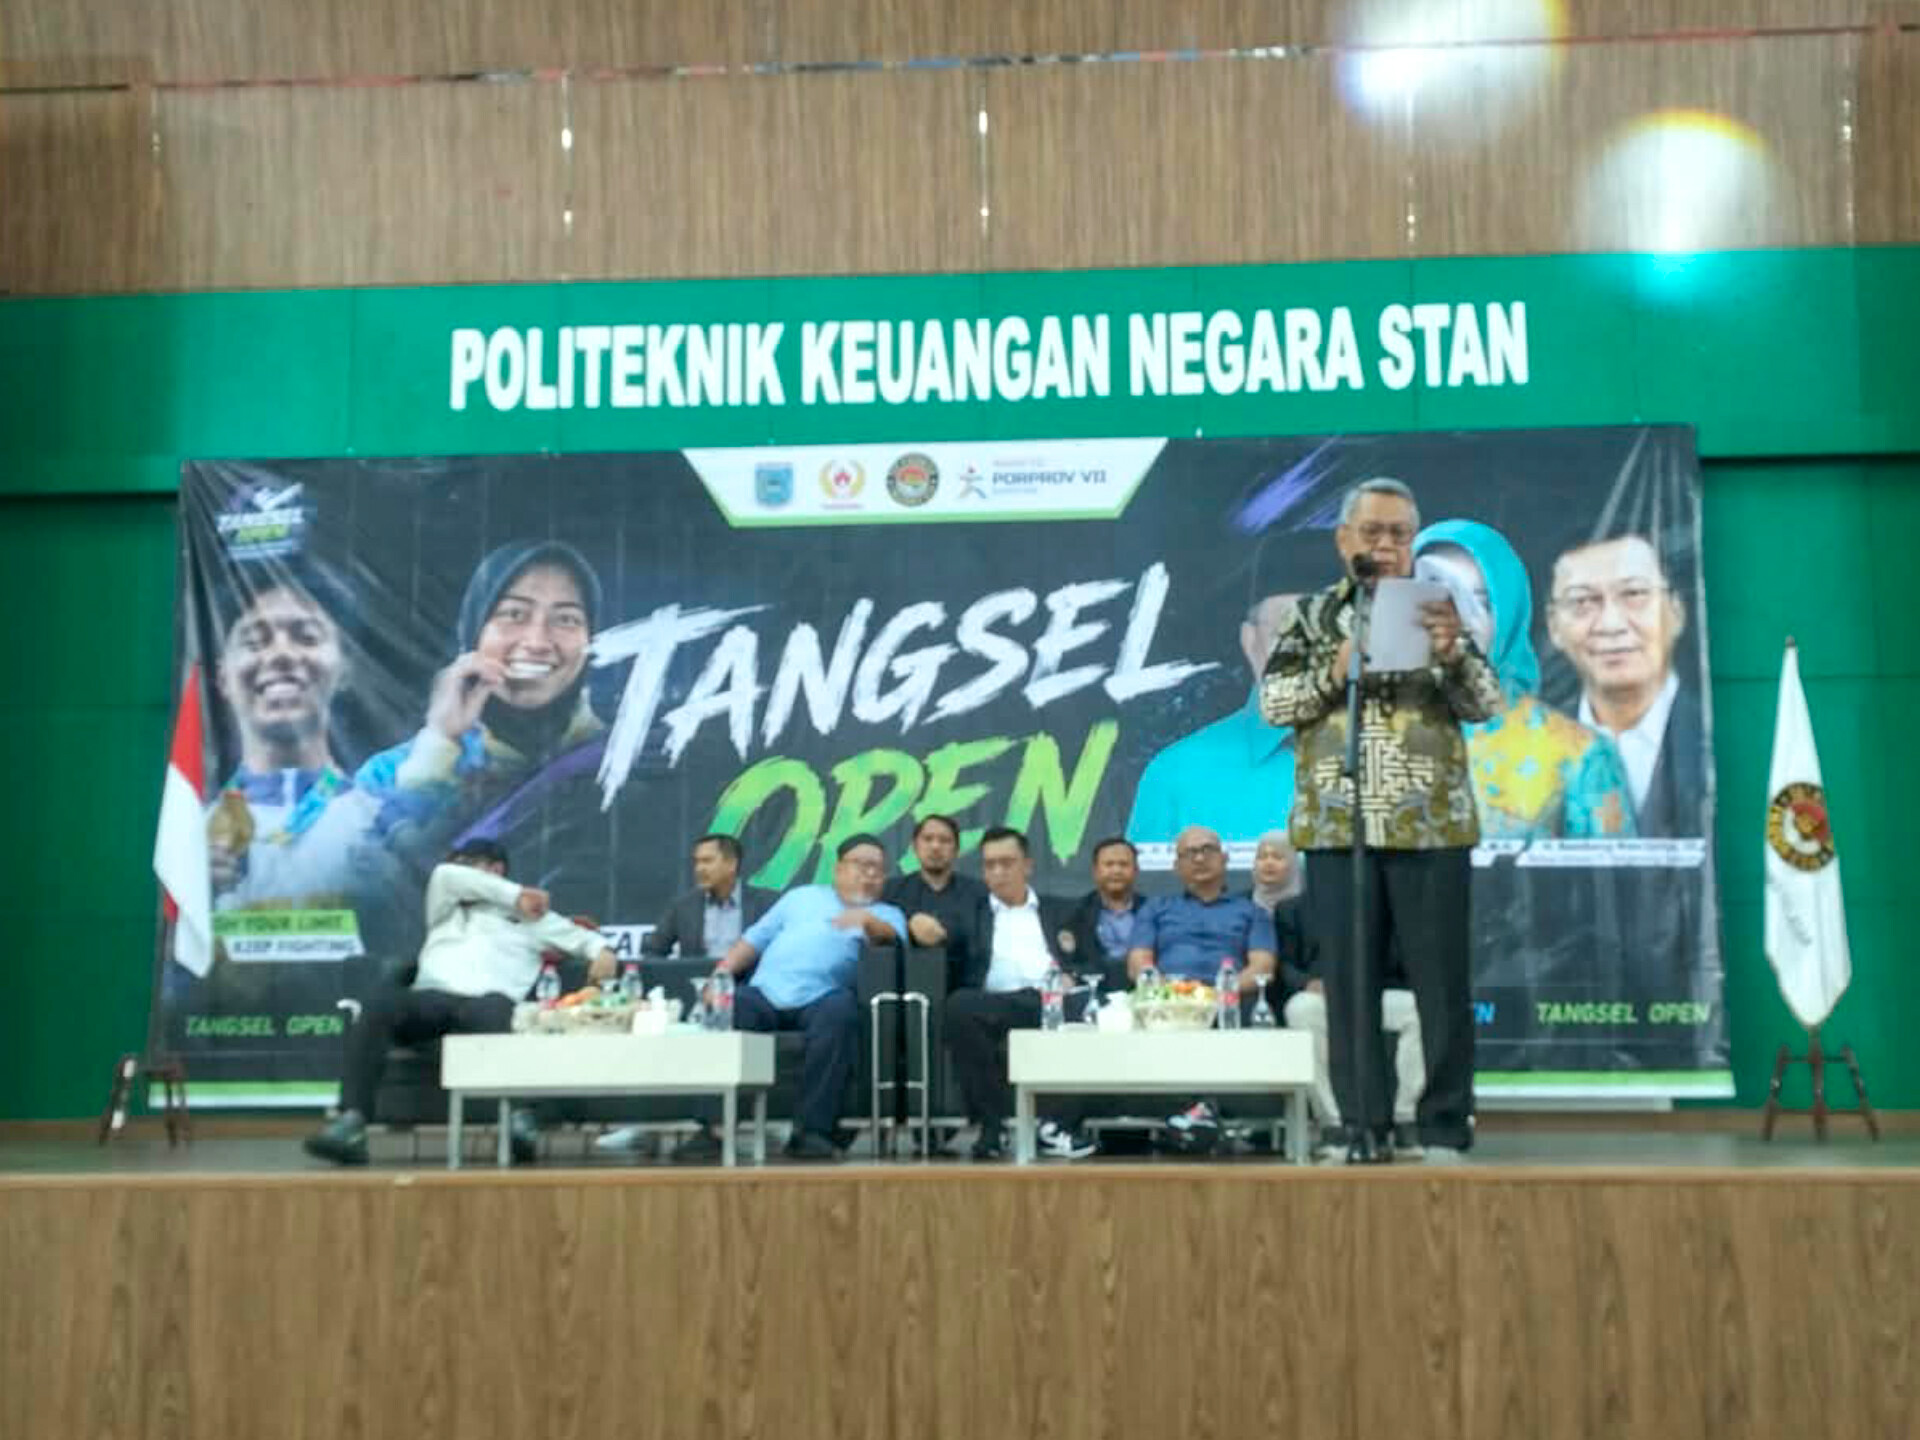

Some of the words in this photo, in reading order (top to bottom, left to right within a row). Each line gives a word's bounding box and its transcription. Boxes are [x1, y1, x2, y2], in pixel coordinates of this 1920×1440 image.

[450, 322, 786, 411] POLITEKNIK
[801, 315, 1110, 405] KEUANGAN
[1128, 306, 1365, 396] NEGARA
[1378, 301, 1530, 390] STAN
[992, 470, 1076, 485] PORPROV
[1080, 469, 1107, 484] VII
[584, 562, 1222, 812] TANGSEL
[705, 720, 1120, 893] OPEN
[186, 1016, 275, 1037] TANGSEL
[286, 1015, 345, 1036] OPEN
[1537, 1002, 1638, 1024] TANGSEL
[1648, 1002, 1711, 1023] OPEN
